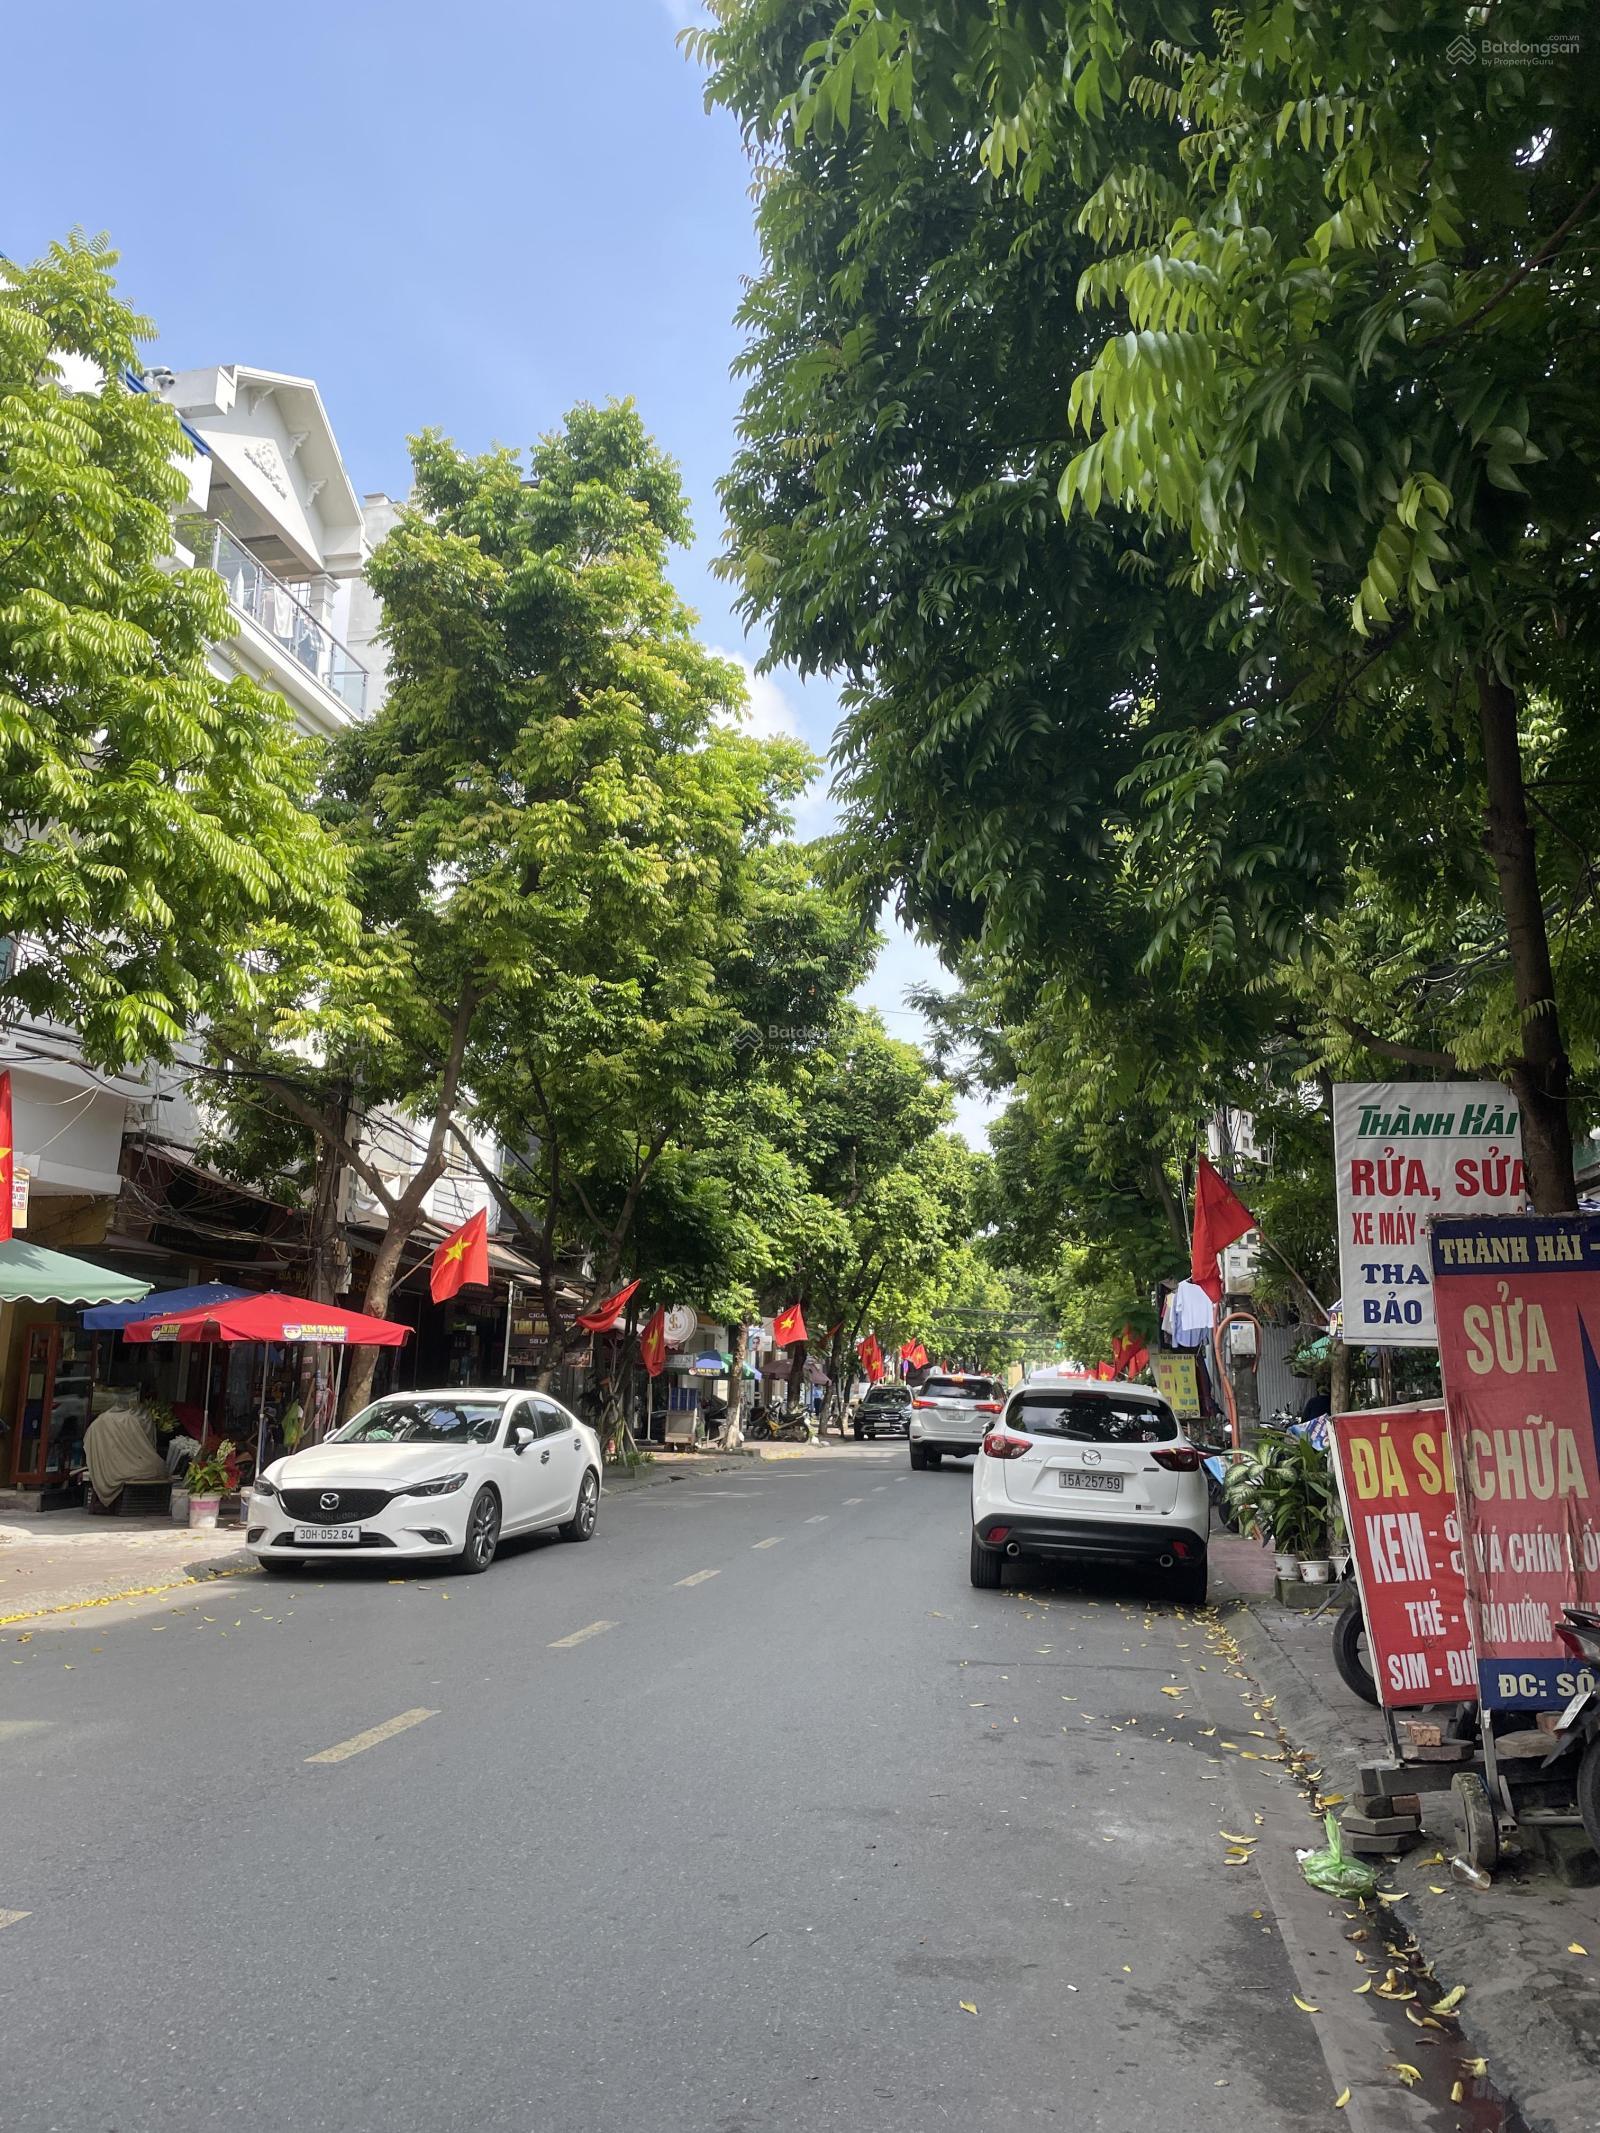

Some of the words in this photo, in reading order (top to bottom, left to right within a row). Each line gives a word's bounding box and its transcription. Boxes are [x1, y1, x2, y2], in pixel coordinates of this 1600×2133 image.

[1351, 1146, 1441, 1201] RỬA,
[1351, 1212, 1374, 1246] XE
[1378, 1204, 1417, 1246] MÁY
[1438, 1231, 1530, 1265] THÀNH
[1535, 1227, 1584, 1262] HẢI
[1363, 1291, 1423, 1325] BẢO
[1462, 1281, 1558, 1375] SỬA
[1350, 1422, 1410, 1500] ĐÁ
[1462, 1413, 1590, 1501] CHỮA
[1364, 1511, 1432, 1585] KEM
[1471, 1524, 1506, 1573] VÁ
[1508, 1524, 1563, 1574] CHÍN
[1403, 1587, 1448, 1638] THẺ
[1481, 1588, 1508, 1644] BẢO
[1387, 1652, 1431, 1692] SIM
[1498, 1673, 1549, 1697] ĐC:
